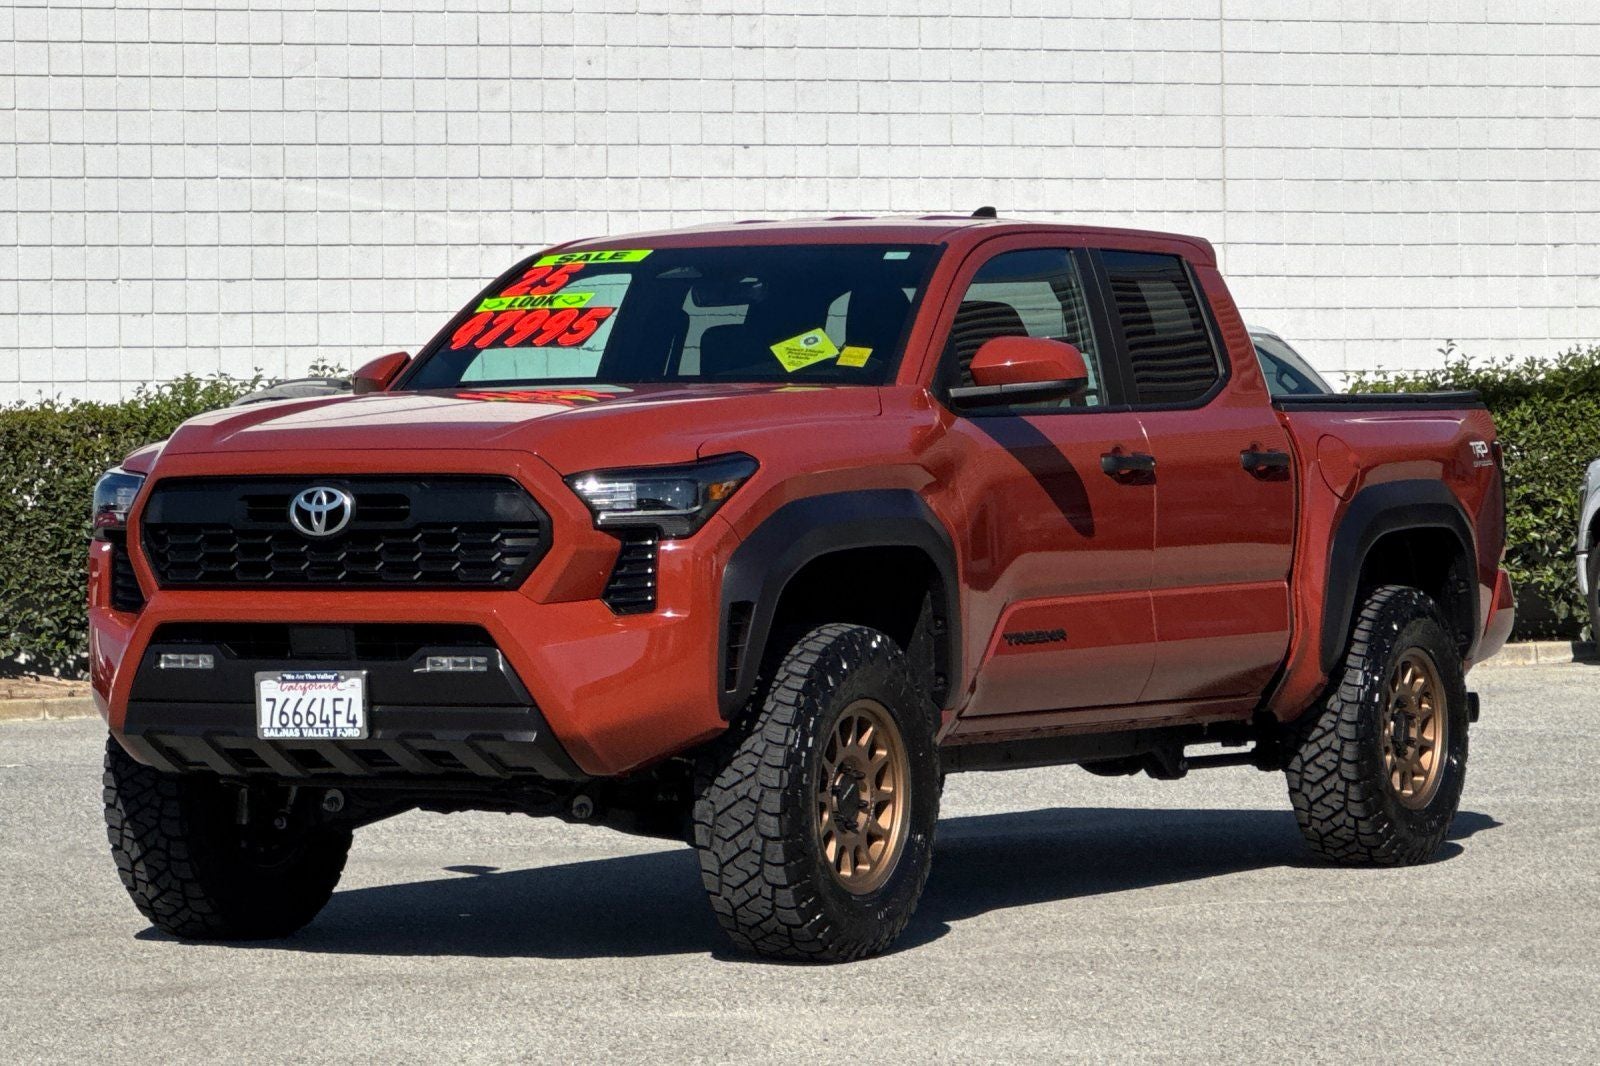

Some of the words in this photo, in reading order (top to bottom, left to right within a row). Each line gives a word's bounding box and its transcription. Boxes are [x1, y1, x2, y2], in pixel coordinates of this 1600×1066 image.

[555, 252, 631, 263] SALE
[500, 261, 586, 296] 25
[505, 295, 560, 309] LOOK
[450, 307, 615, 349] 47995
[280, 681, 346, 696] California
[265, 697, 357, 727] 76664F4
[263, 728, 301, 737] SALINAS
[302, 728, 334, 737] VALLEY
[337, 728, 360, 737] FORD
